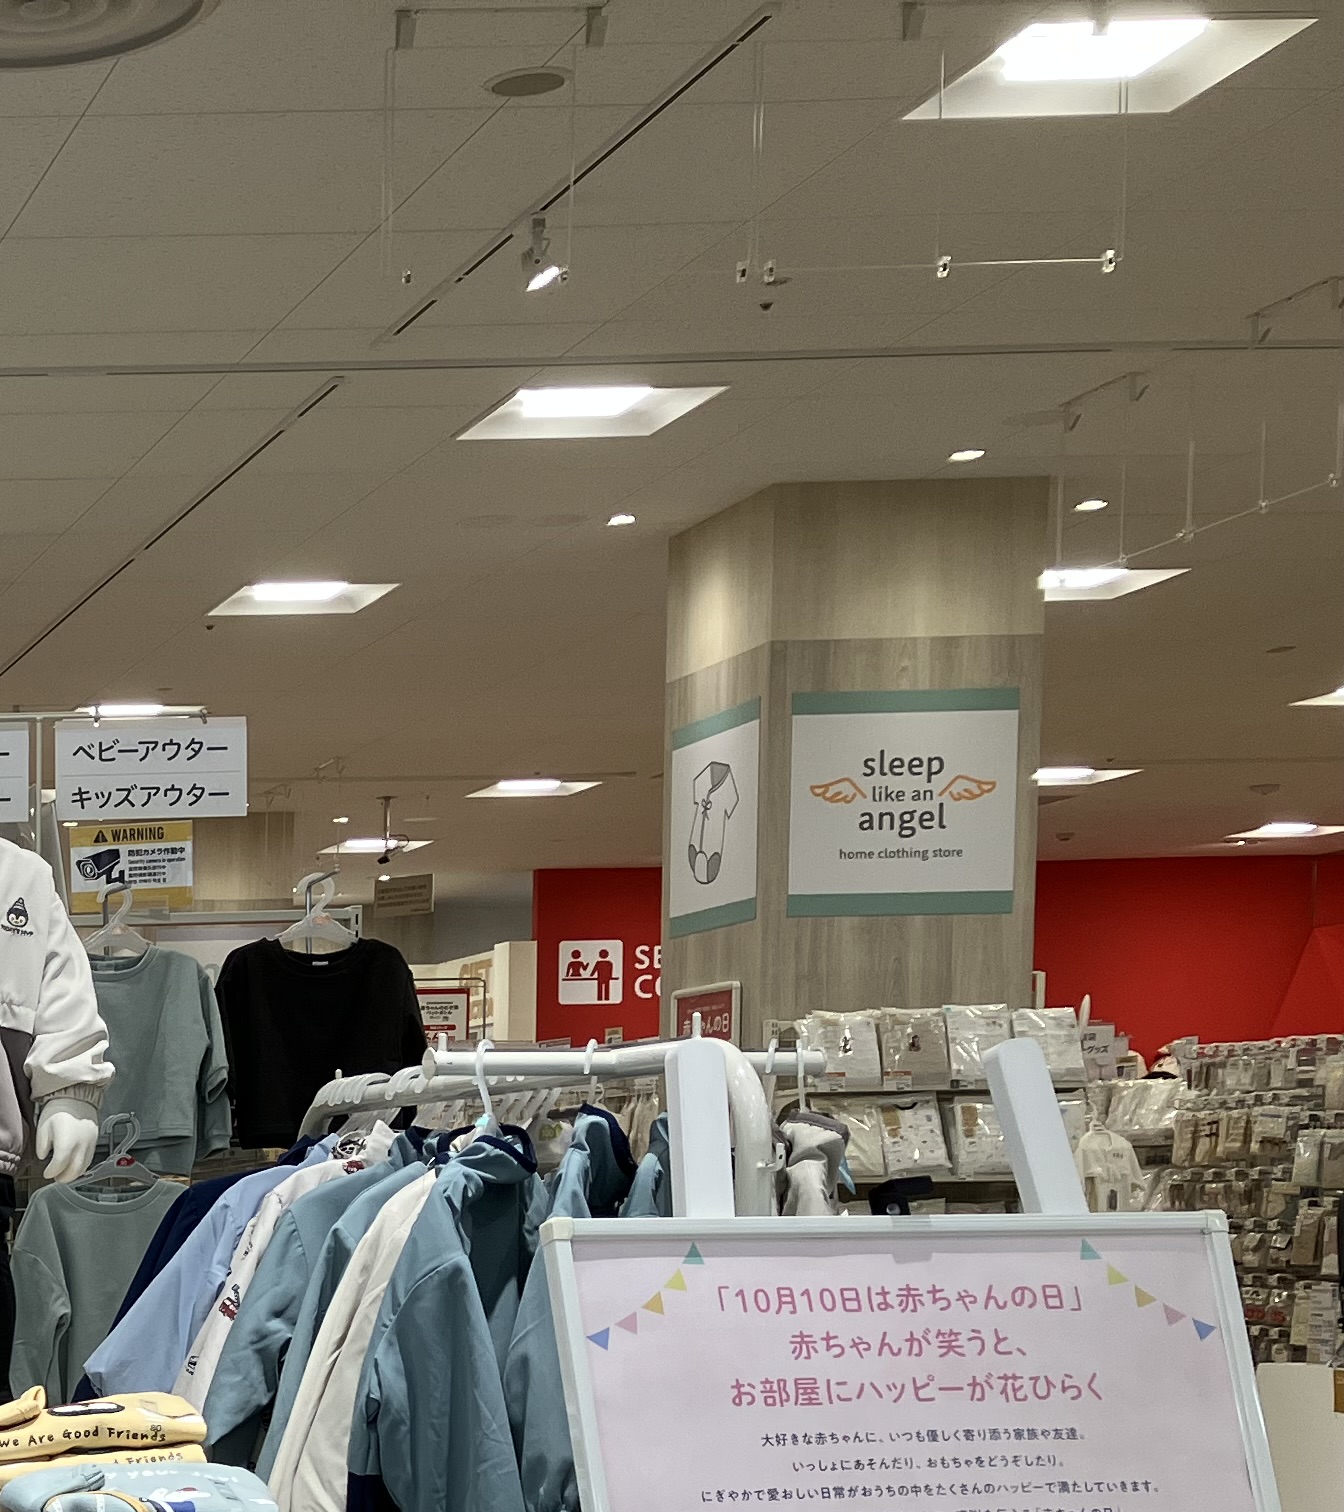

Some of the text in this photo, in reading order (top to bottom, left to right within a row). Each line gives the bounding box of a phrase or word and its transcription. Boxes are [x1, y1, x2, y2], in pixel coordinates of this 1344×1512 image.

[72, 738, 228, 762] ベビーアウター
[862, 749, 945, 783] sleep
[71, 783, 230, 809] キッズアウター
[872, 786, 934, 802] like an
[859, 802, 946, 838] angel
[111, 827, 164, 842] WARNING
[839, 847, 963, 861] home clothing store
[717, 1283, 1082, 1315] 「10月10日は赤ちゃんの日」
[789, 1328, 1027, 1360] 赤ちゃんが笑うと、
[730, 1372, 1103, 1407] お部屋にハッピーが花ひらく
[27, 1433, 54, 1447] Are
[62, 1426, 99, 1440] Good
[107, 1427, 166, 1442] Friends
[126, 1451, 184, 1465] Friends
